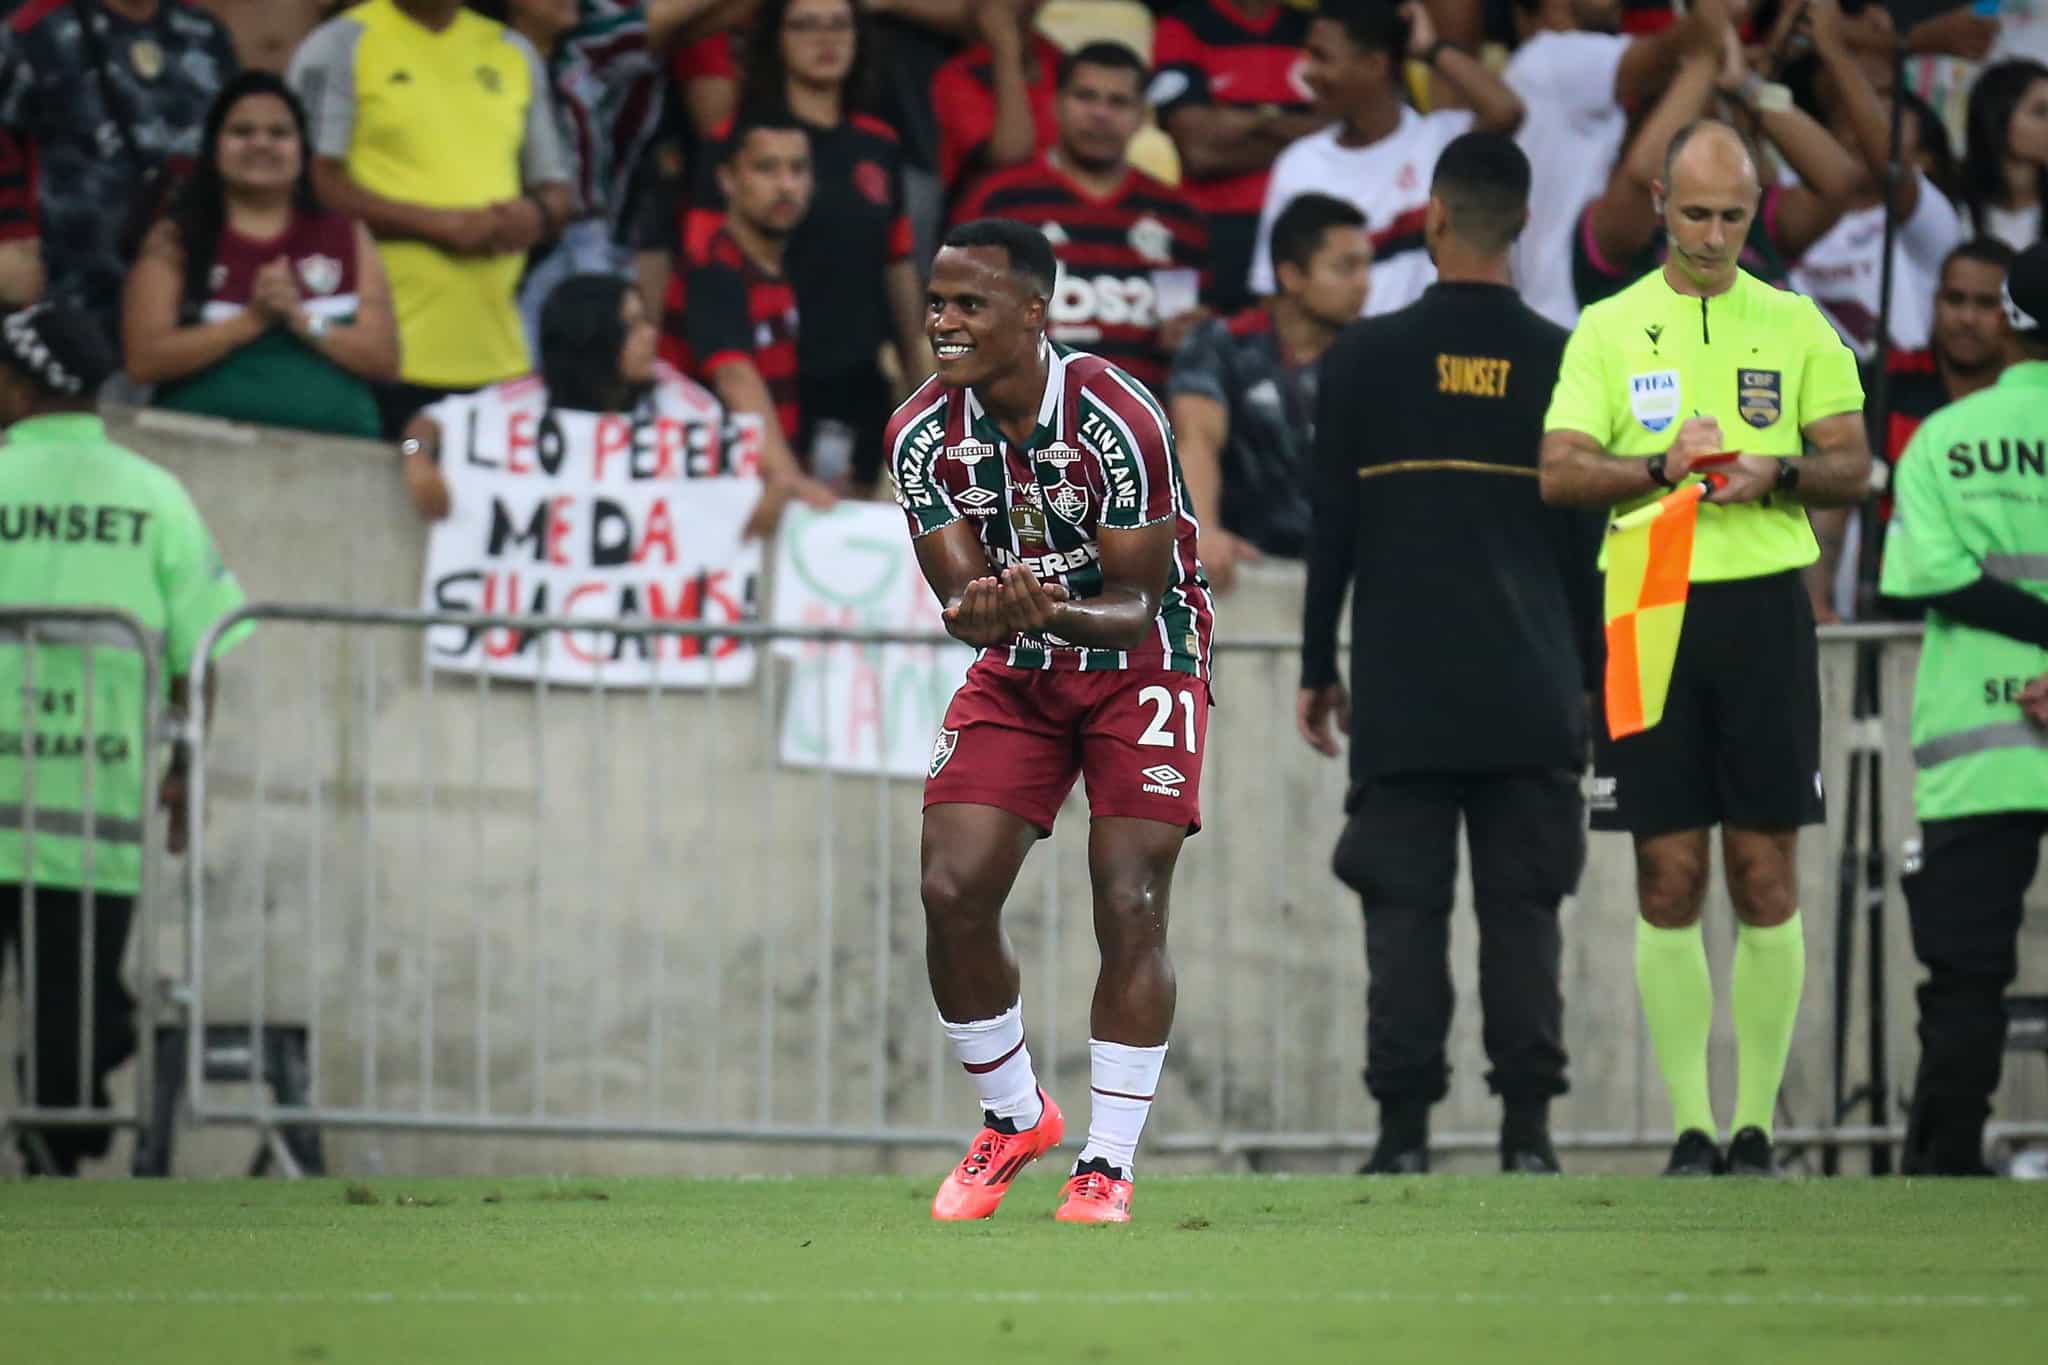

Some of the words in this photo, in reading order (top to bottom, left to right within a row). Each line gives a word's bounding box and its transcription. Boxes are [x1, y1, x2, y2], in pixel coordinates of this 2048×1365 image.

[1437, 354, 1511, 397] SUNSET
[1635, 376, 1674, 392] FIFA
[902, 420, 945, 508] ZINZANE
[1082, 412, 1137, 508] ZINZANE
[963, 506, 998, 515] umbro
[1984, 677, 2034, 705] SE
[1137, 685, 1197, 754] 21
[1142, 783, 1181, 797] umbro
